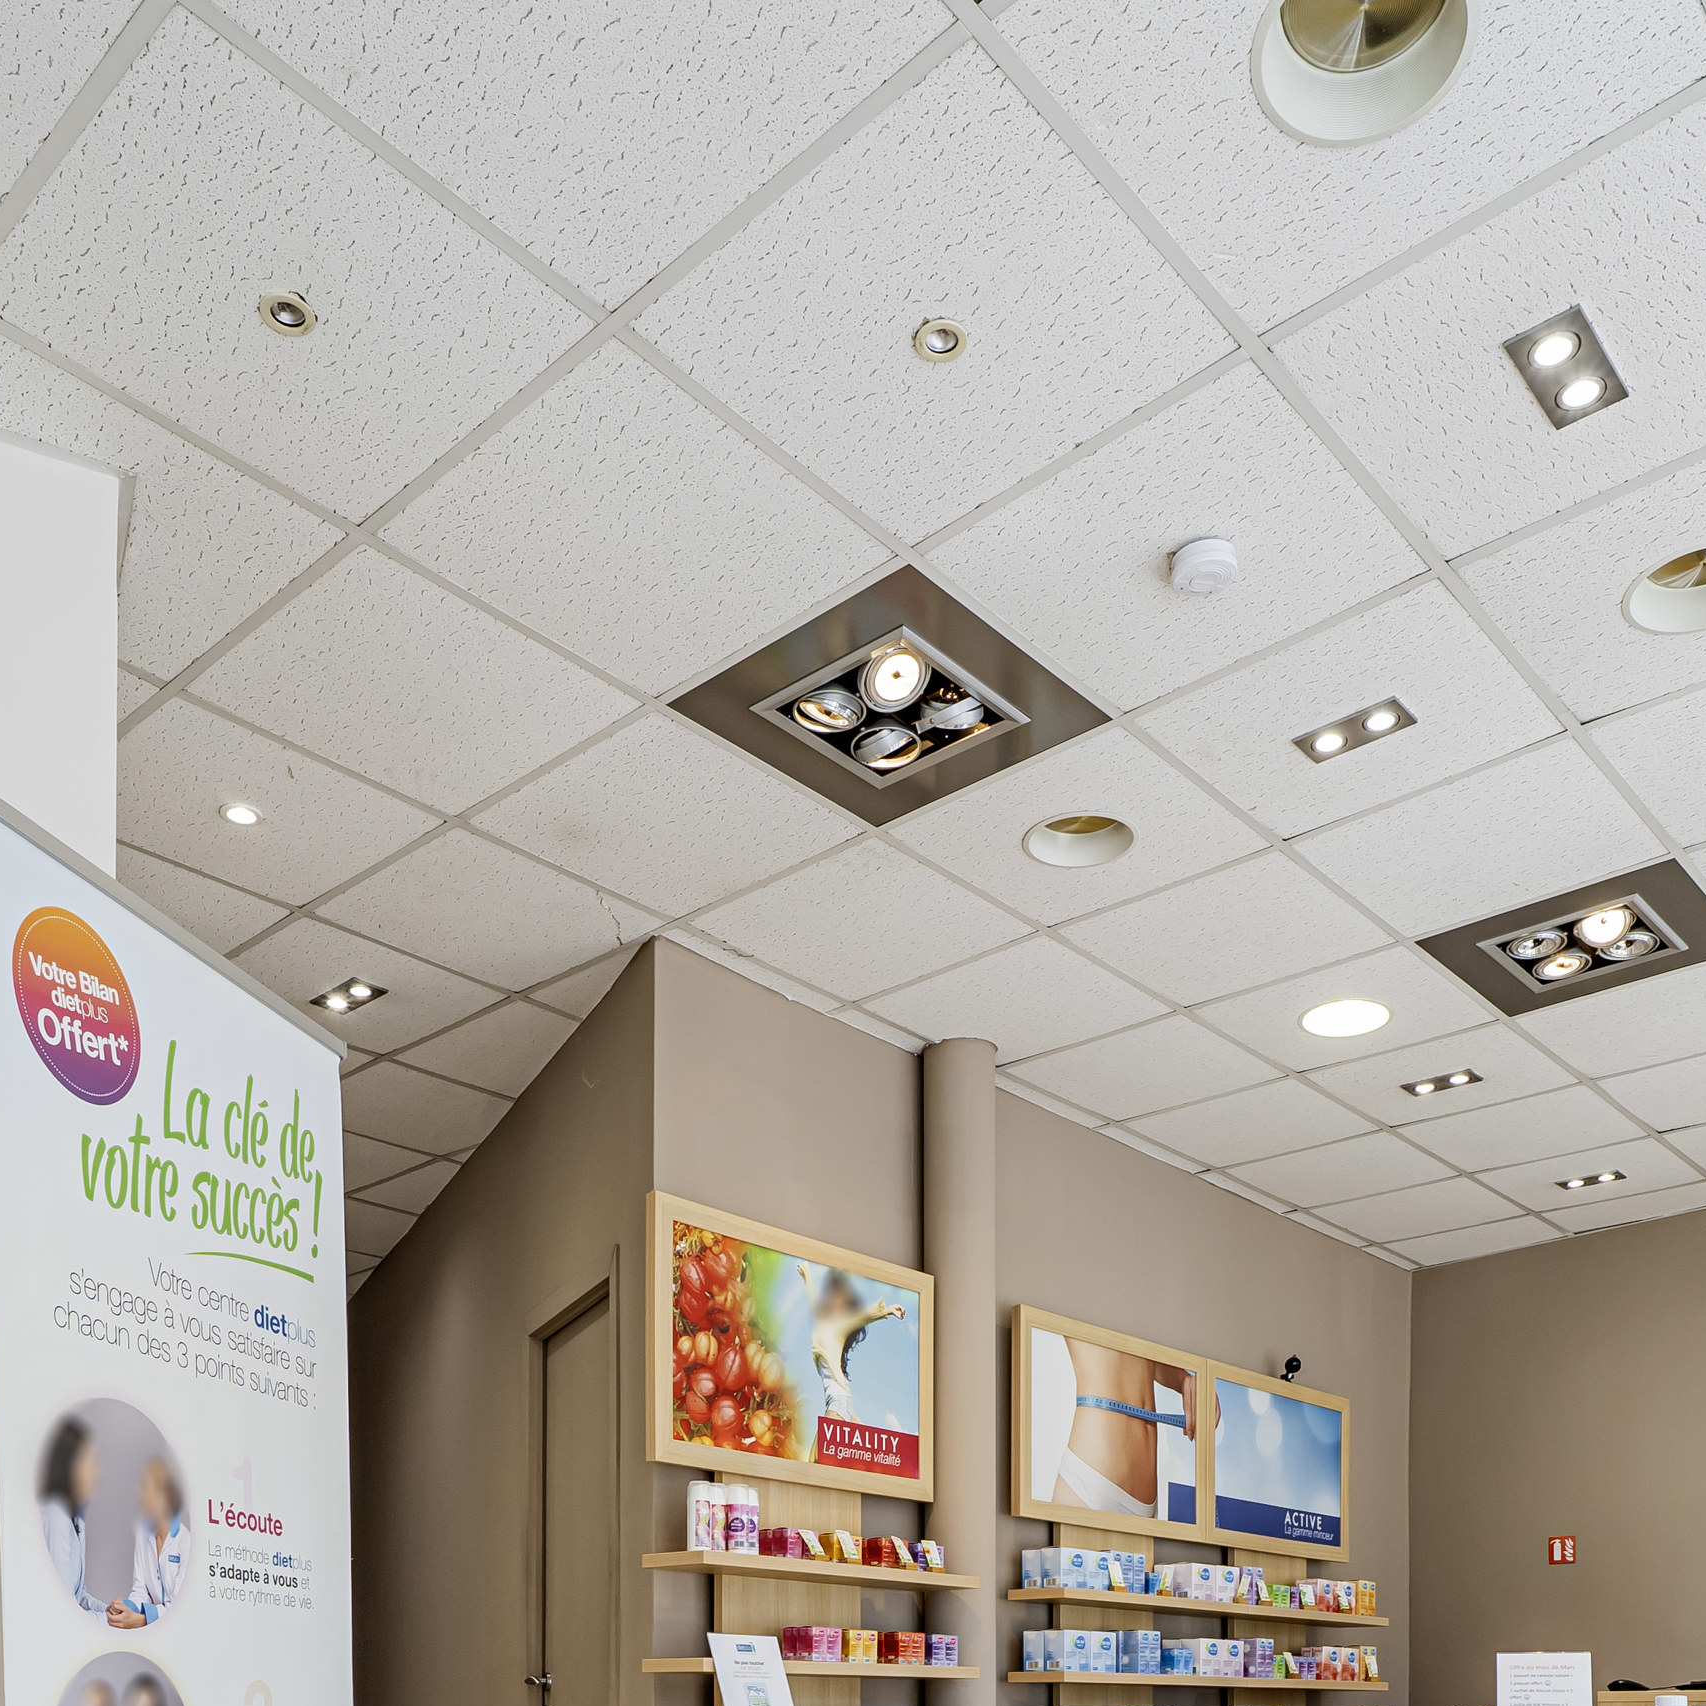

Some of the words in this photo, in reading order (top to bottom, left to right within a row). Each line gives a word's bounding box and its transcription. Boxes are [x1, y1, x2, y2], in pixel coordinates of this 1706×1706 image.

[28, 951, 77, 989] Votre
[79, 970, 120, 1006] Bilan
[51, 986, 109, 1024] dietplus
[163, 1039, 210, 1151] La
[224, 1073, 271, 1169] clé
[279, 1088, 316, 1184] de
[81, 1112, 179, 1222] votre
[191, 1174, 302, 1254] succès
[147, 1257, 193, 1300] Votre
[197, 1286, 250, 1322] centre
[253, 1304, 316, 1348] dietplus
[69, 1268, 159, 1324] s'engage
[163, 1300, 175, 1330] à
[181, 1312, 222, 1346] vous
[227, 1328, 291, 1371] satisfaire
[295, 1355, 317, 1379] sur
[53, 1302, 131, 1350] chacun
[137, 1330, 171, 1363] des
[177, 1341, 189, 1368] 3
[195, 1352, 245, 1387] points
[249, 1371, 309, 1408] suivants
[823, 1422, 900, 1454] VITALITY
[823, 1441, 835, 1455] La
[836, 1445, 872, 1462] gamme
[873, 1449, 901, 1467] vitalité
[208, 1499, 283, 1536] L'écoute
[1284, 1510, 1323, 1530] ACTIVE
[1284, 1524, 1292, 1536] La
[1292, 1526, 1313, 1539] gamme
[1313, 1526, 1334, 1541] minceur
[208, 1539, 222, 1557] La
[225, 1544, 270, 1565] méthode
[272, 1552, 313, 1572] dietplus
[209, 1562, 260, 1584] s'adapte
[263, 1569, 269, 1584] à
[273, 1575, 298, 1588] vous
[301, 1577, 310, 1591] et
[209, 1581, 216, 1598] à
[219, 1585, 246, 1601] votre
[248, 1589, 281, 1607] rythme
[284, 1592, 296, 1608] de
[299, 1594, 314, 1610] vie.
